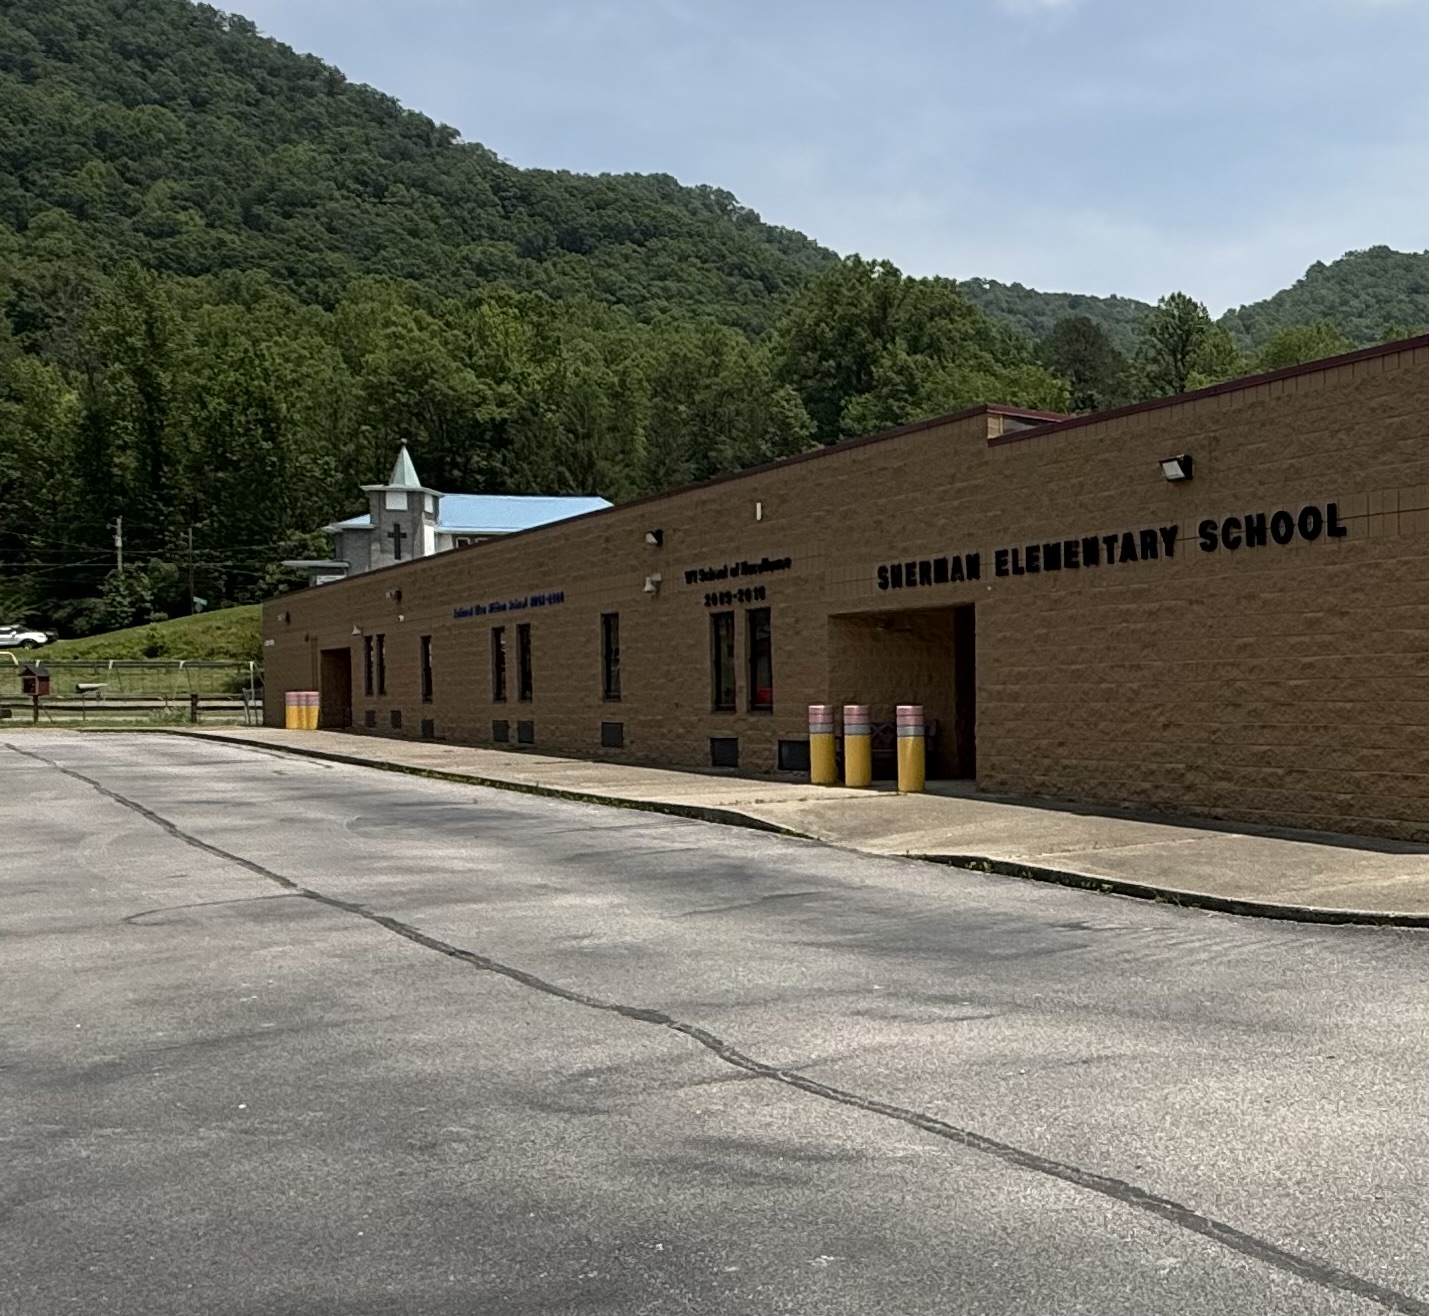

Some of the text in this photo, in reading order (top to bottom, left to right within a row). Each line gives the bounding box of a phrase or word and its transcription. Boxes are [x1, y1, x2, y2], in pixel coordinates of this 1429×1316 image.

[876, 502, 1348, 592] SHERMAN ELEMENTARY SCHOOL
